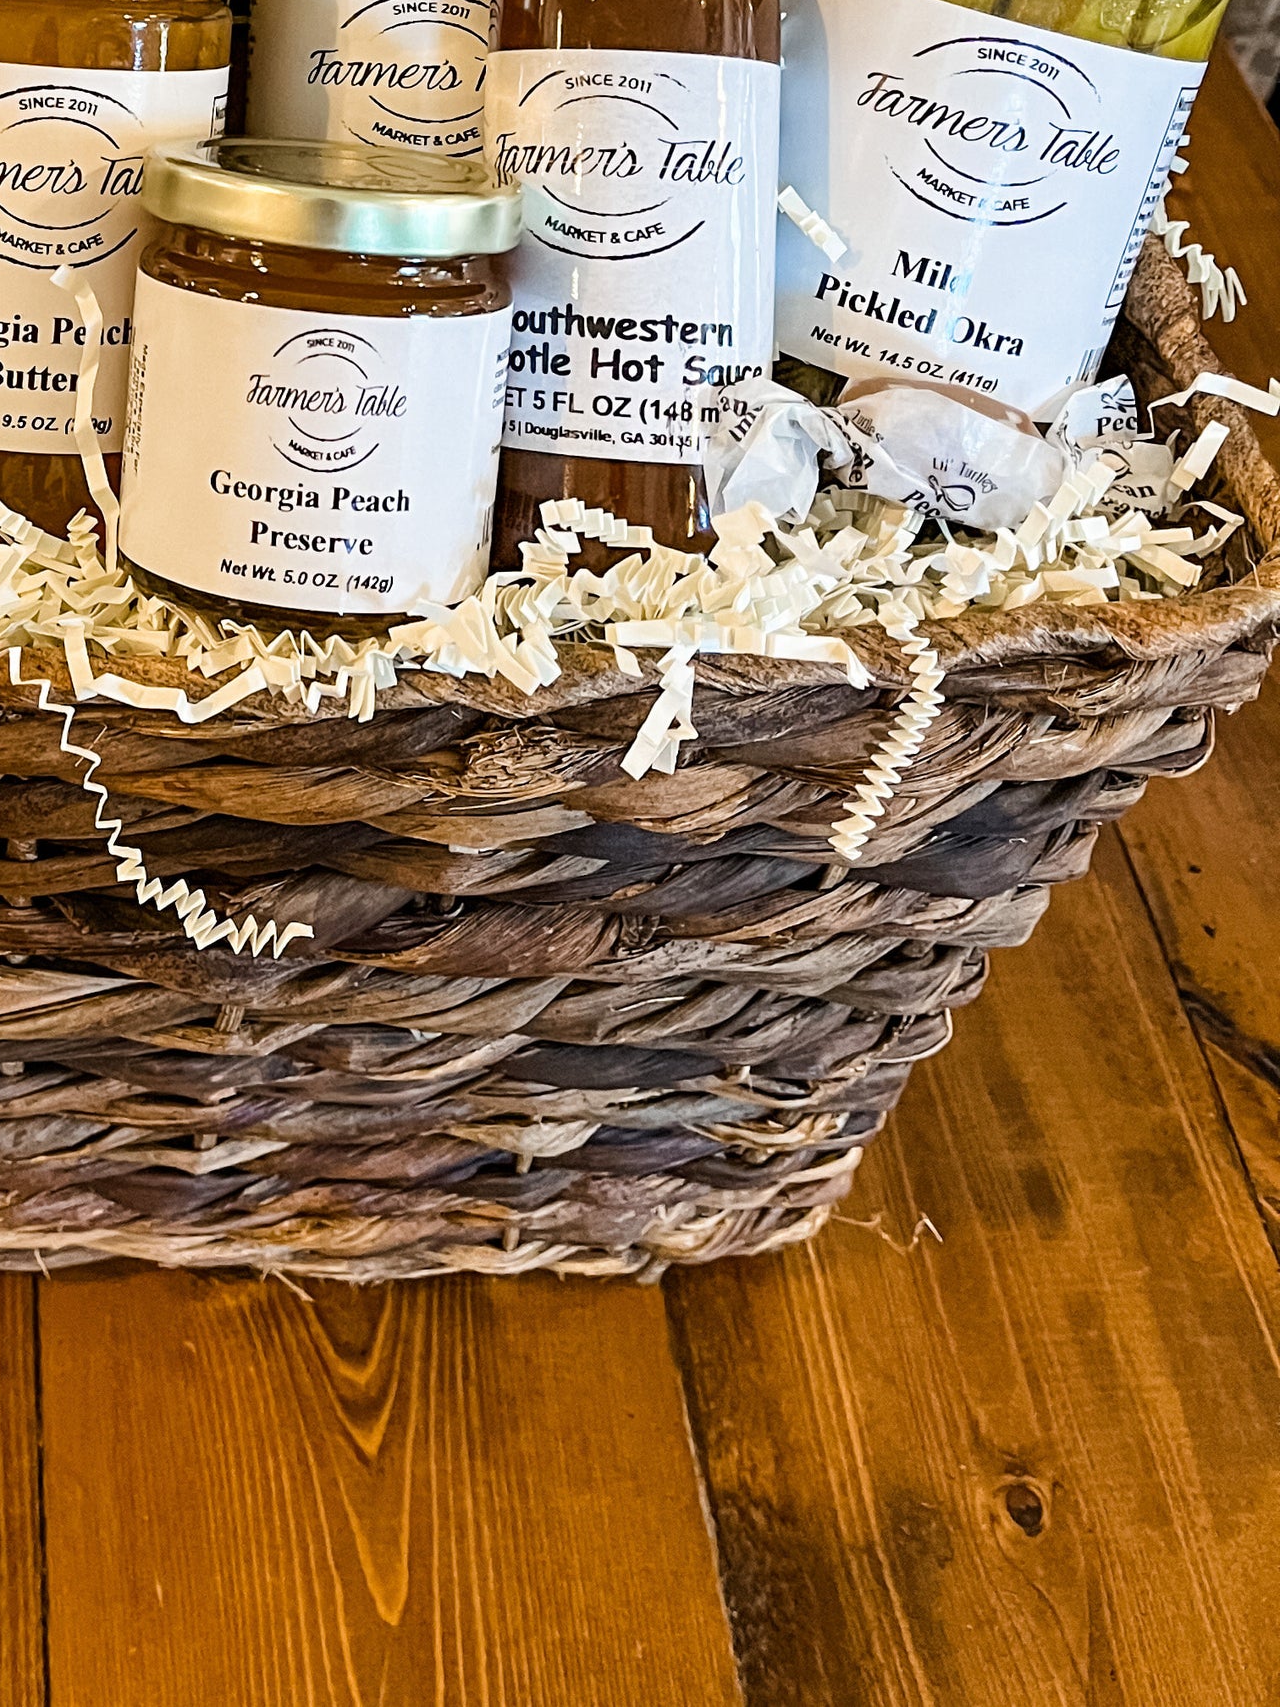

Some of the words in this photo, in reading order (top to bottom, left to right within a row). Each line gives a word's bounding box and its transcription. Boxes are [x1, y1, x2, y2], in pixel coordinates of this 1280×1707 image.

[392, 1, 437, 15] SINCE
[441, 3, 470, 19] 2011
[307, 49, 462, 90] Farmer's
[978, 47, 1028, 67] SINCE
[1031, 58, 1060, 81] 2011
[565, 73, 614, 90] SINCE
[619, 75, 653, 93] 2011
[19, 97, 65, 111] SINCE
[69, 99, 98, 116] 2011
[857, 71, 1028, 153] Farmer's
[1040, 121, 1120, 176] Table
[372, 121, 430, 146] MARKET
[445, 127, 481, 146] CAFE
[493, 132, 643, 188] Farmer's
[657, 137, 746, 186] Table
[917, 167, 977, 208] MARKET
[68, 233, 104, 254] CAFE
[545, 215, 606, 244] MARKET
[624, 223, 666, 243] CAFE
[51, 317, 133, 346] Pech
[814, 272, 938, 335] Pickled
[950, 316, 1025, 358] Okra
[307, 338, 335, 349] SINCE
[336, 340, 355, 353] 2011
[811, 325, 842, 347] Net
[845, 338, 872, 359] Wt.
[878, 347, 914, 371] 14.5
[917, 359, 945, 379] OZ
[949, 368, 999, 394] (411g)
[591, 347, 665, 383] Hot
[246, 374, 346, 413] Farmer's
[355, 385, 407, 418] Table
[532, 390, 546, 410] 5
[553, 391, 584, 414] FL
[593, 395, 631, 418] OZ
[640, 398, 693, 425] (148
[2, 415, 26, 429] 9.5
[29, 417, 59, 431] OZ
[525, 421, 615, 445] Douglasville,
[621, 433, 644, 444] GA
[288, 439, 324, 461] MARKET
[333, 446, 356, 461] CAFE
[210, 469, 320, 512] Georgia
[331, 486, 410, 512] Peach
[249, 520, 374, 556] Preserve
[220, 558, 247, 577] Net
[251, 564, 277, 583] Wt.
[283, 568, 308, 585] 5.0
[312, 572, 338, 588] OZ
[346, 575, 394, 592] (142g)
